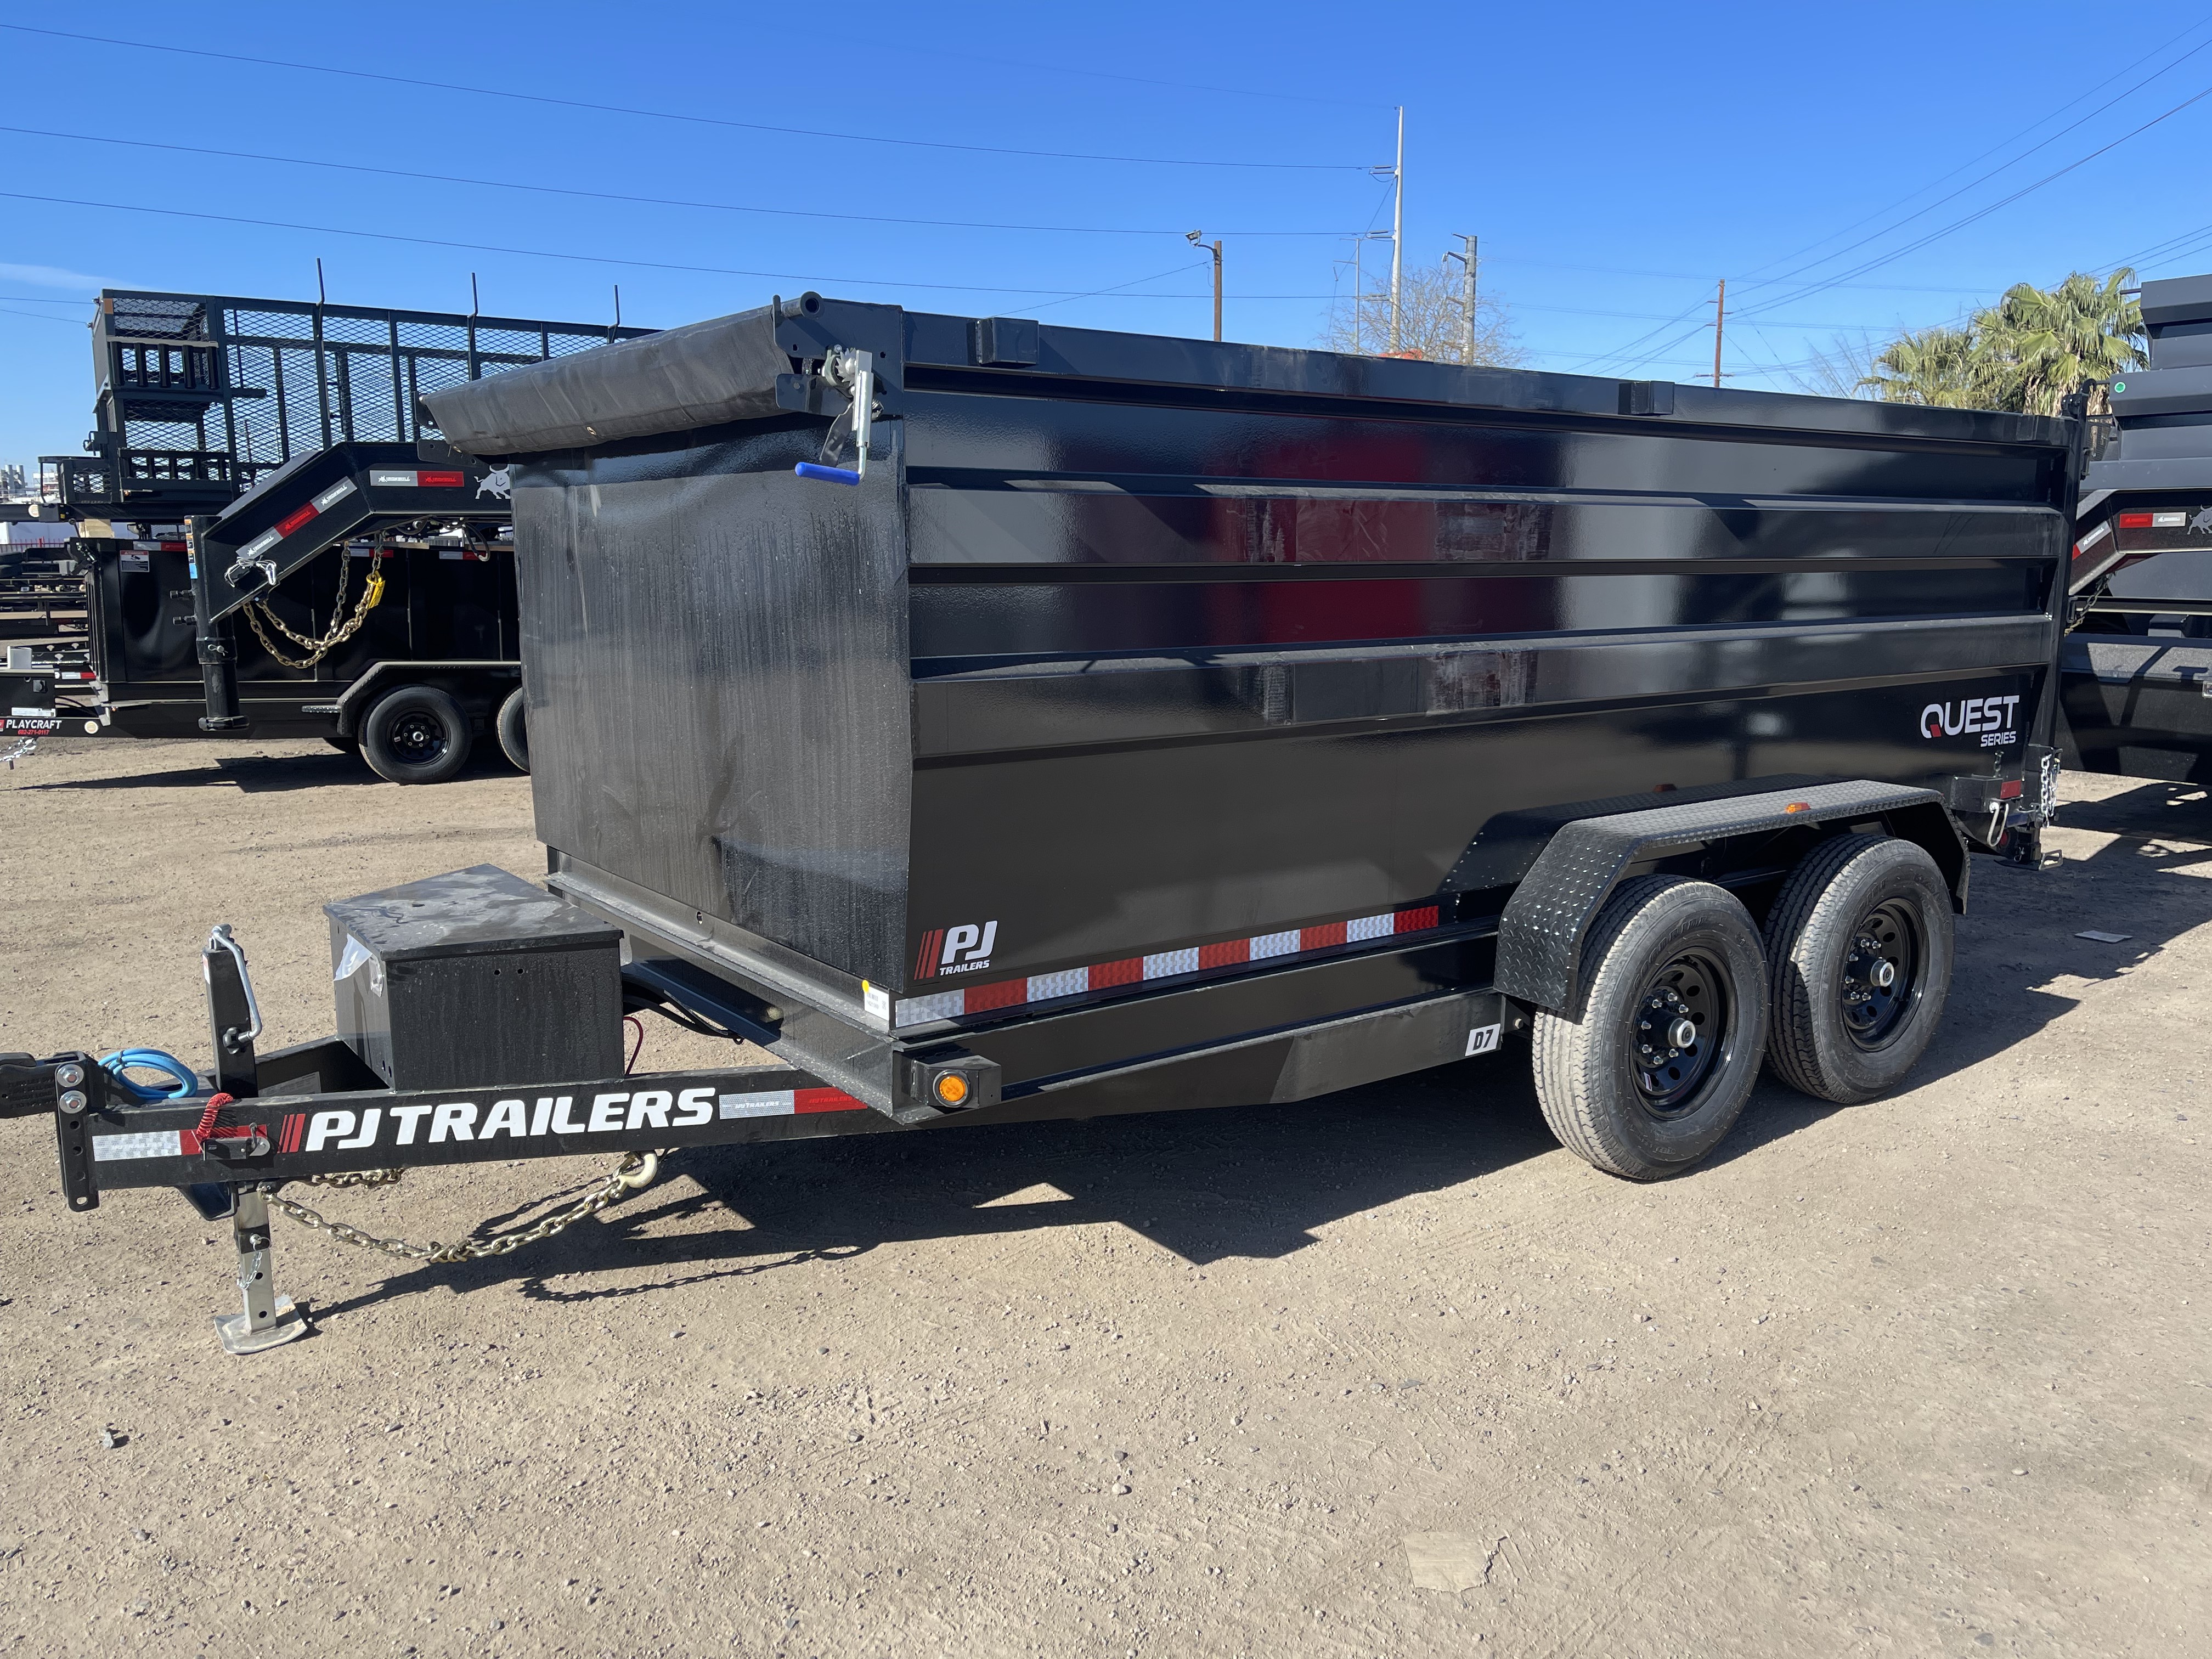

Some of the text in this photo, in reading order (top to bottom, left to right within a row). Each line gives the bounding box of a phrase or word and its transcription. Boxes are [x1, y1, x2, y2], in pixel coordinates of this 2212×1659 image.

[6, 719, 62, 729] PLAYCRAFT
[1921, 695, 2019, 738] QUEST
[1980, 731, 2016, 747] SERIES
[941, 920, 998, 965] PJ
[939, 960, 990, 976] TRAILERS
[1472, 1029, 1493, 1051] D7
[306, 1087, 715, 1152] PJ TRAILERS
